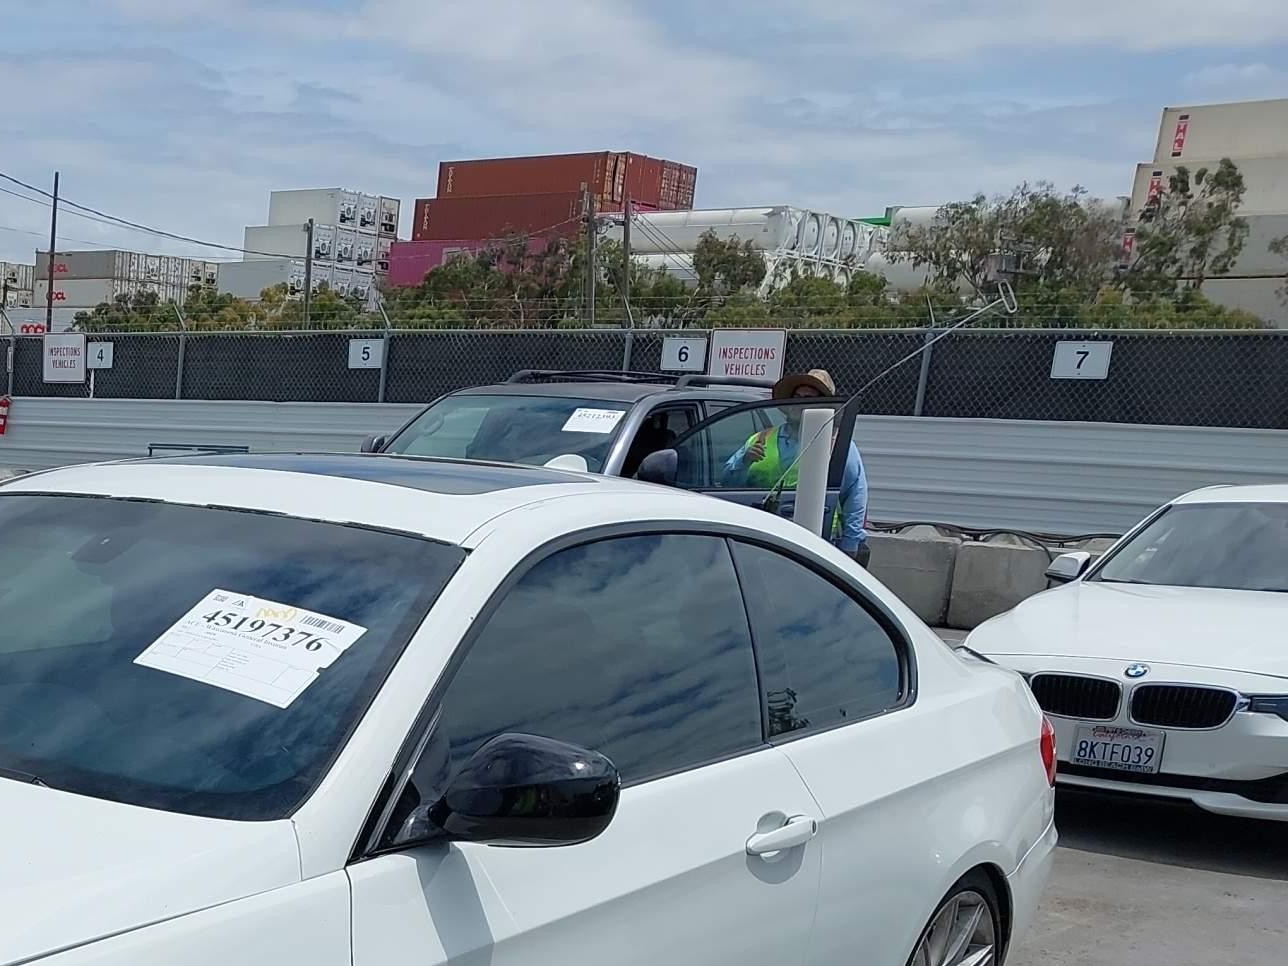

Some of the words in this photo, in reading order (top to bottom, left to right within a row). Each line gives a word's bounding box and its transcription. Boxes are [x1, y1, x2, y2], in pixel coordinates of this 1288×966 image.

[47, 347, 81, 357] INSPECTIONS
[97, 348, 105, 363] 4
[362, 346, 371, 361] 5
[678, 345, 689, 363] 6
[718, 347, 776, 360] INSPECTIONS
[52, 360, 76, 369] VEHICLES
[1076, 351, 1089, 369] 7
[724, 363, 766, 376] VEHICLES
[202, 610, 324, 651] 45197376
[1077, 740, 1155, 765] 8KTF039
